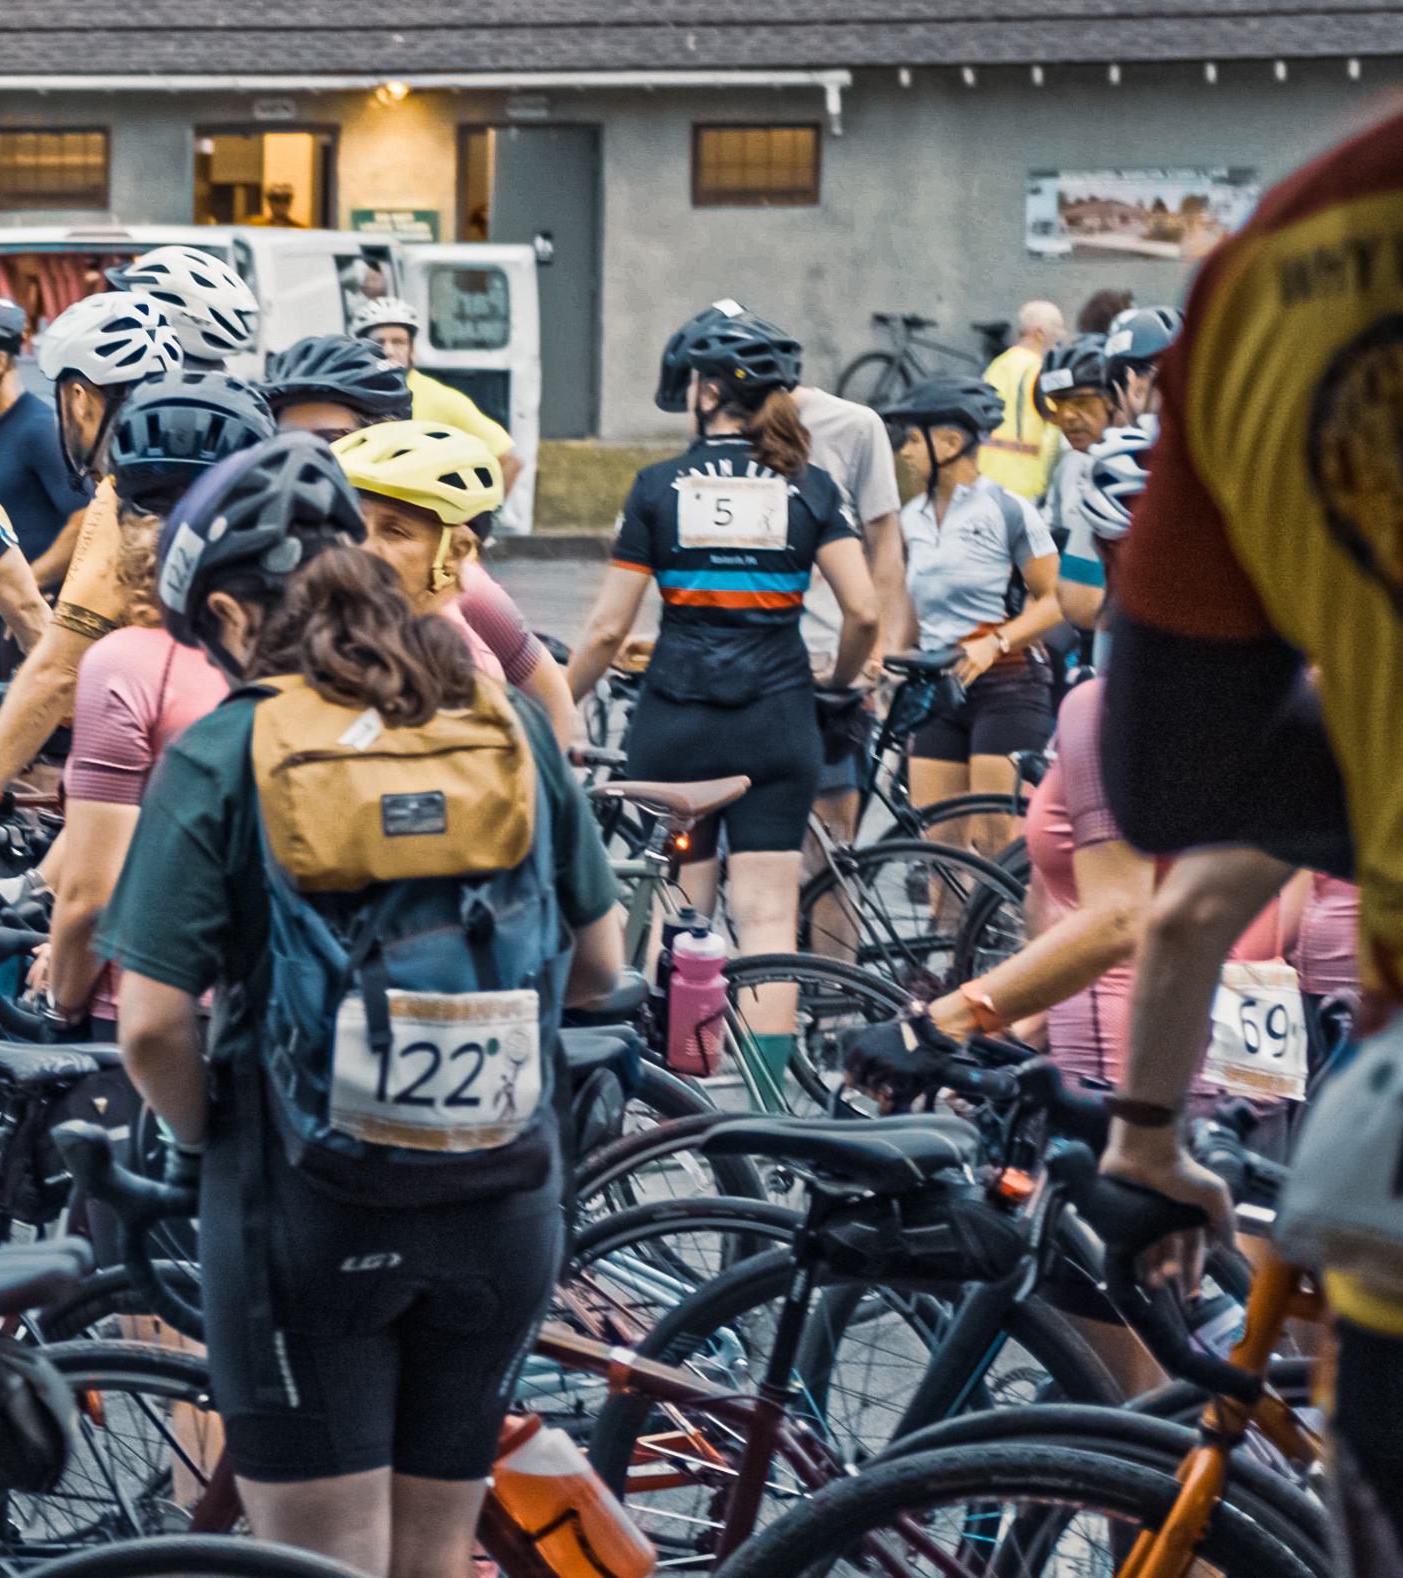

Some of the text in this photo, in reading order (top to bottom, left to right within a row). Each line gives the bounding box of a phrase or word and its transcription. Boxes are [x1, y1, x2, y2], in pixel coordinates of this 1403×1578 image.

[713, 498, 734, 526] 5
[1239, 998, 1289, 1058] 69
[372, 1041, 485, 1107] 122
